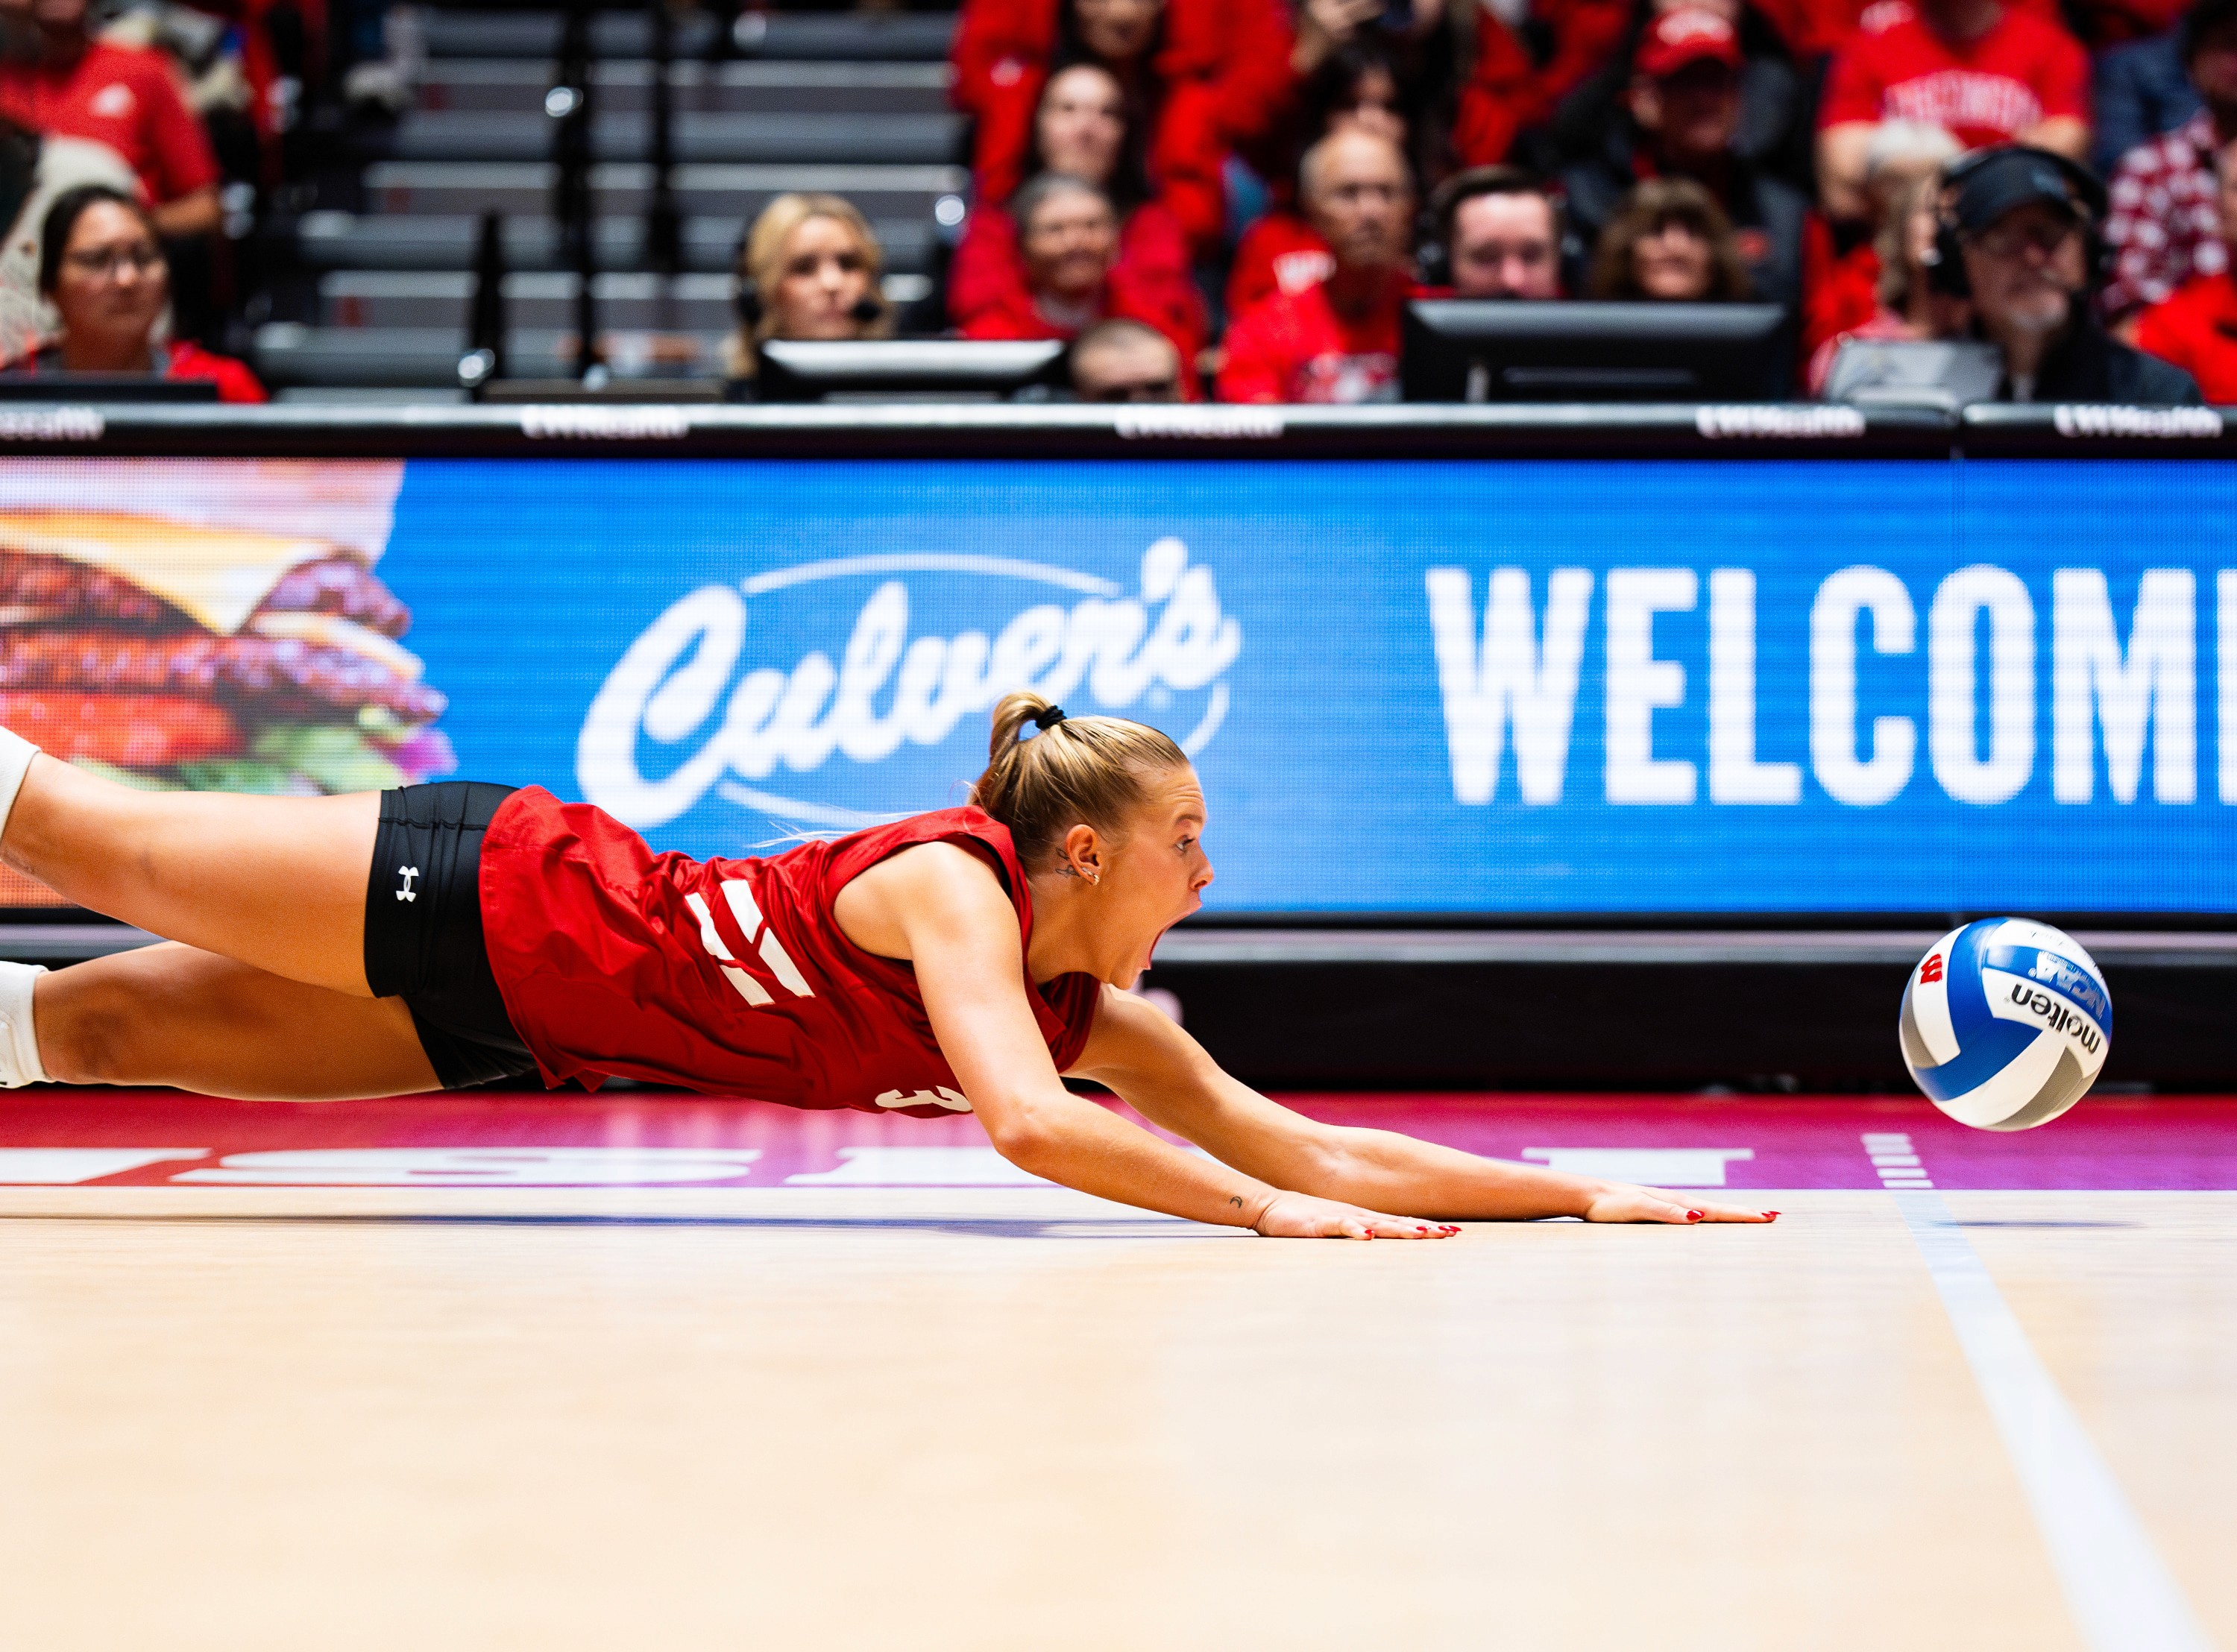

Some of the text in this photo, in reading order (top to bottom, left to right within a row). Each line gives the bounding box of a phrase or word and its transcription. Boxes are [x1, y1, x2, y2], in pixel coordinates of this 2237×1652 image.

[576, 537, 1241, 827] Culver's
[1426, 564, 2237, 807] WELCOM
[2011, 983, 2101, 1055] molten
